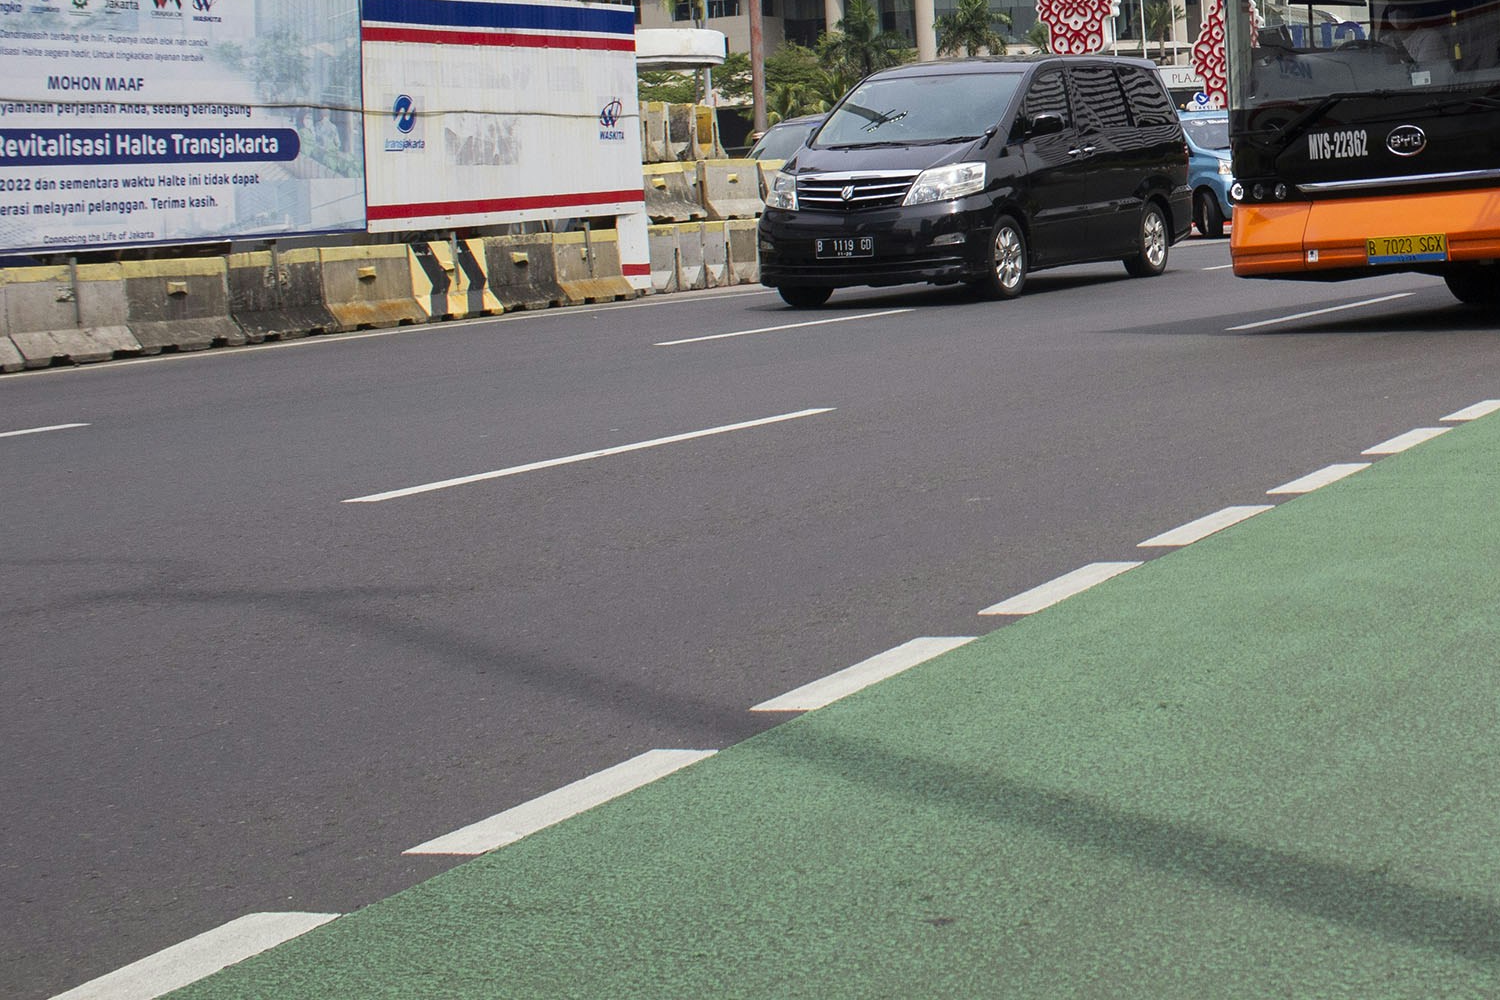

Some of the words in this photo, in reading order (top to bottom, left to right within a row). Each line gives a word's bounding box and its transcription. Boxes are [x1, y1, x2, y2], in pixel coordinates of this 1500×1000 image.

[104, 0, 140, 10] Jakarta
[48, 76, 100, 91] MOHON
[105, 77, 144, 91] MAAF
[1172, 73, 1204, 84] PLAZ
[57, 103, 116, 117] perjalanan
[119, 104, 150, 116] Anda,
[152, 104, 190, 117] sedang
[192, 104, 251, 118] berlangsung
[600, 130, 624, 140] WASKITA
[1390, 133, 1421, 147] BYD
[116, 134, 167, 155] Halte
[171, 132, 279, 158] Transjakarta
[384, 138, 425, 152] transjakarta
[1308, 129, 1368, 160] MYS-22362
[0, 179, 31, 192] 2022
[35, 178, 56, 190] dan
[60, 177, 119, 190] sementara
[122, 176, 155, 188] waktu
[158, 175, 186, 187] Halte
[189, 174, 201, 186] ini
[204, 173, 229, 185] tidak
[232, 173, 260, 187] dapat
[33, 200, 84, 216] melayani
[88, 199, 148, 215] pelanggan.
[151, 196, 186, 210] Terima
[188, 195, 218, 208] kasih.
[43, 234, 87, 244] Connecting
[88, 233, 100, 242] the
[102, 231, 118, 242] Life
[128, 230, 155, 240] Jakarta
[817, 240, 823, 252] B
[833, 239, 854, 251] 1119
[1369, 241, 1376, 256] B
[1383, 238, 1412, 255] 7023
[1419, 236, 1443, 252] SGX
